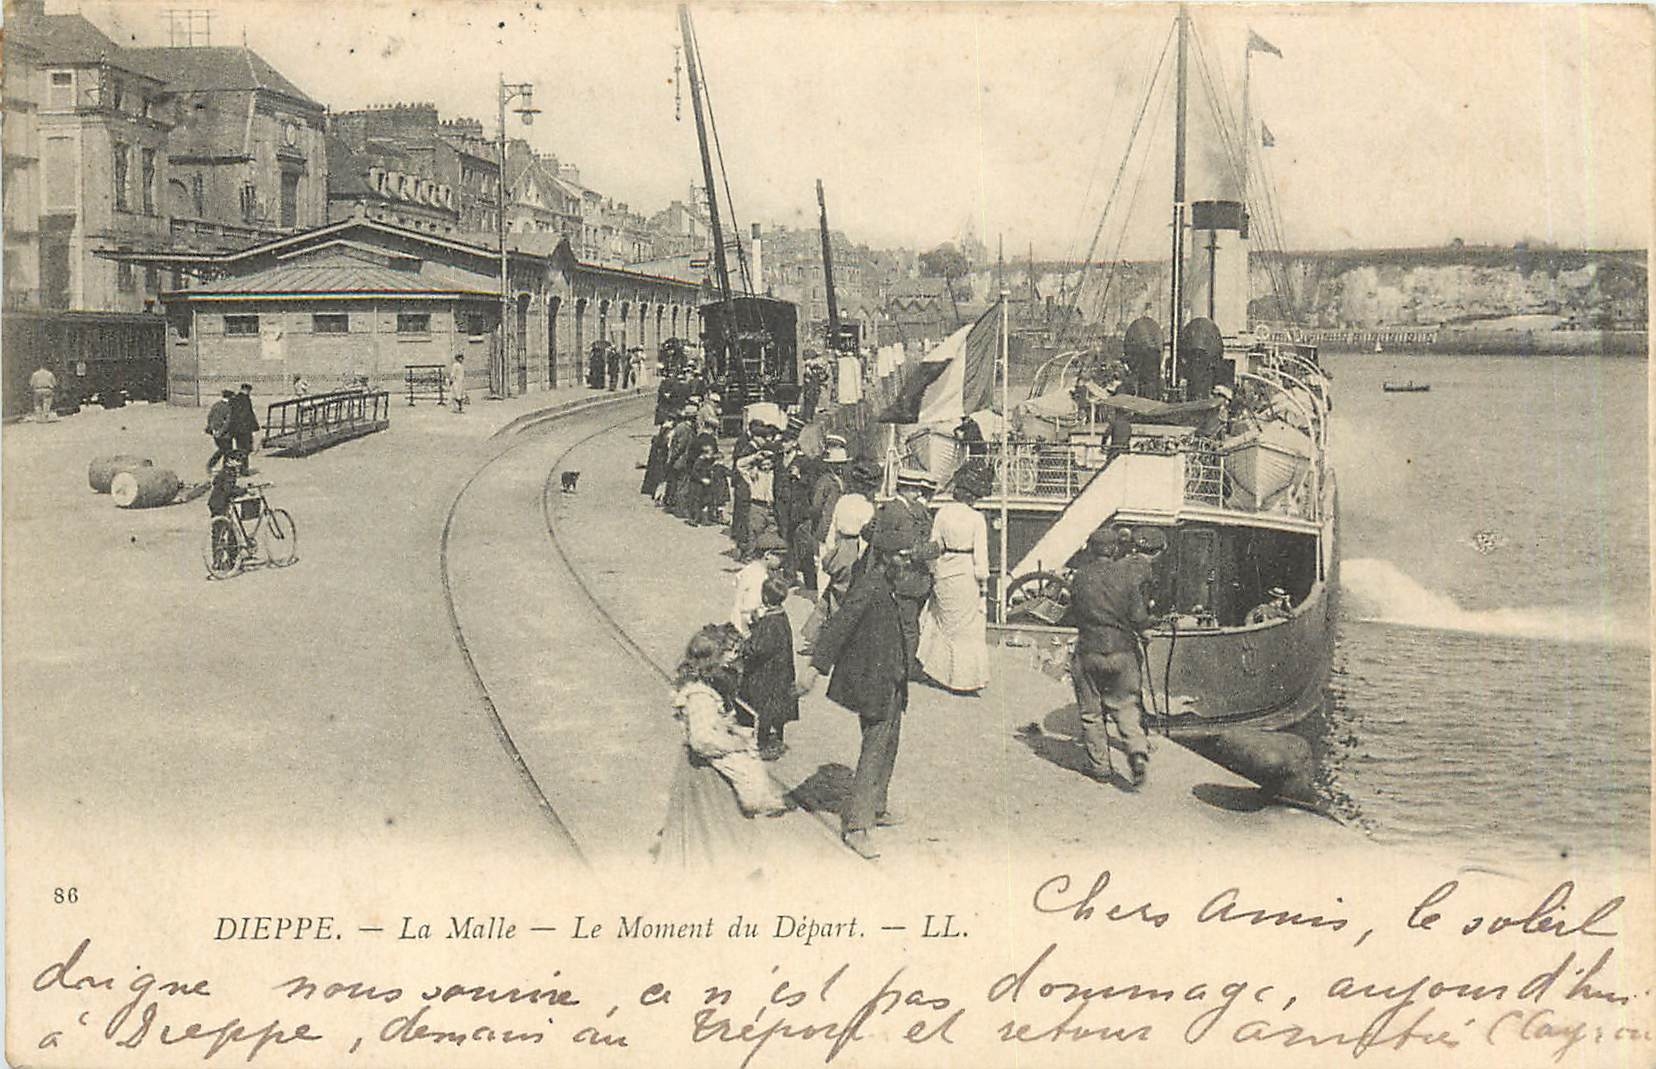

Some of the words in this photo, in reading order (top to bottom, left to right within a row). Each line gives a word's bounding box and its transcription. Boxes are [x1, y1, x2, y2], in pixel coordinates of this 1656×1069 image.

[1033, 870, 1170, 928] Chers
[1408, 880, 1459, 930] le
[1462, 880, 1626, 938] soleil
[272, 976, 403, 1003] nous
[826, 966, 950, 1063] pas
[379, 1005, 544, 1046] demain
[572, 1027, 629, 1047] au
[903, 1008, 966, 1044] et
